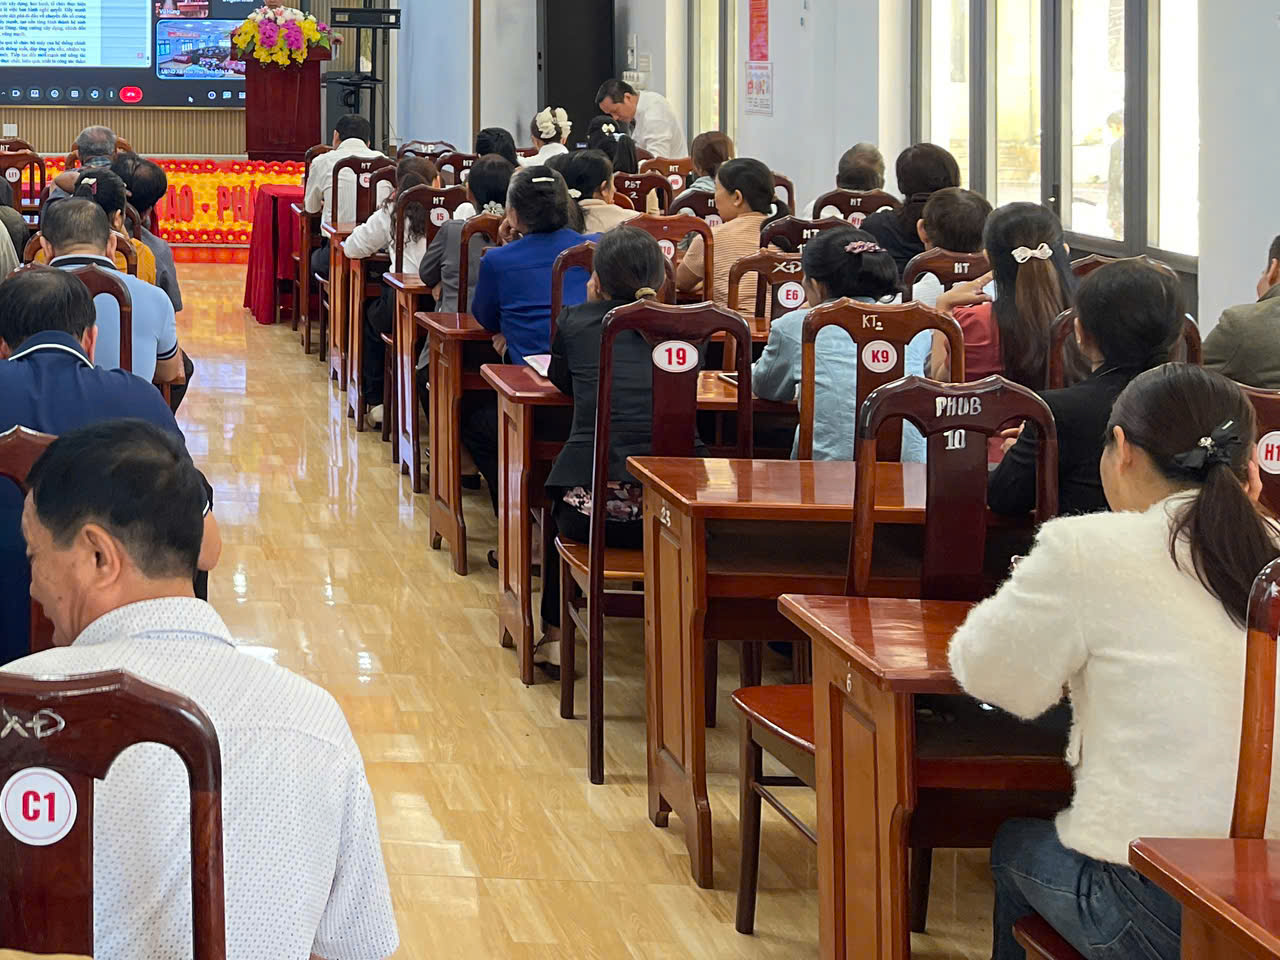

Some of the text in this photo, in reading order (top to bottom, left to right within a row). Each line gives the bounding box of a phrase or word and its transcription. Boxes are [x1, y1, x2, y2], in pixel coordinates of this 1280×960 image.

[785, 290, 798, 300] E6
[665, 348, 687, 366] 19
[871, 350, 890, 364] K9
[943, 429, 966, 450] 10
[21, 791, 56, 823] C1
